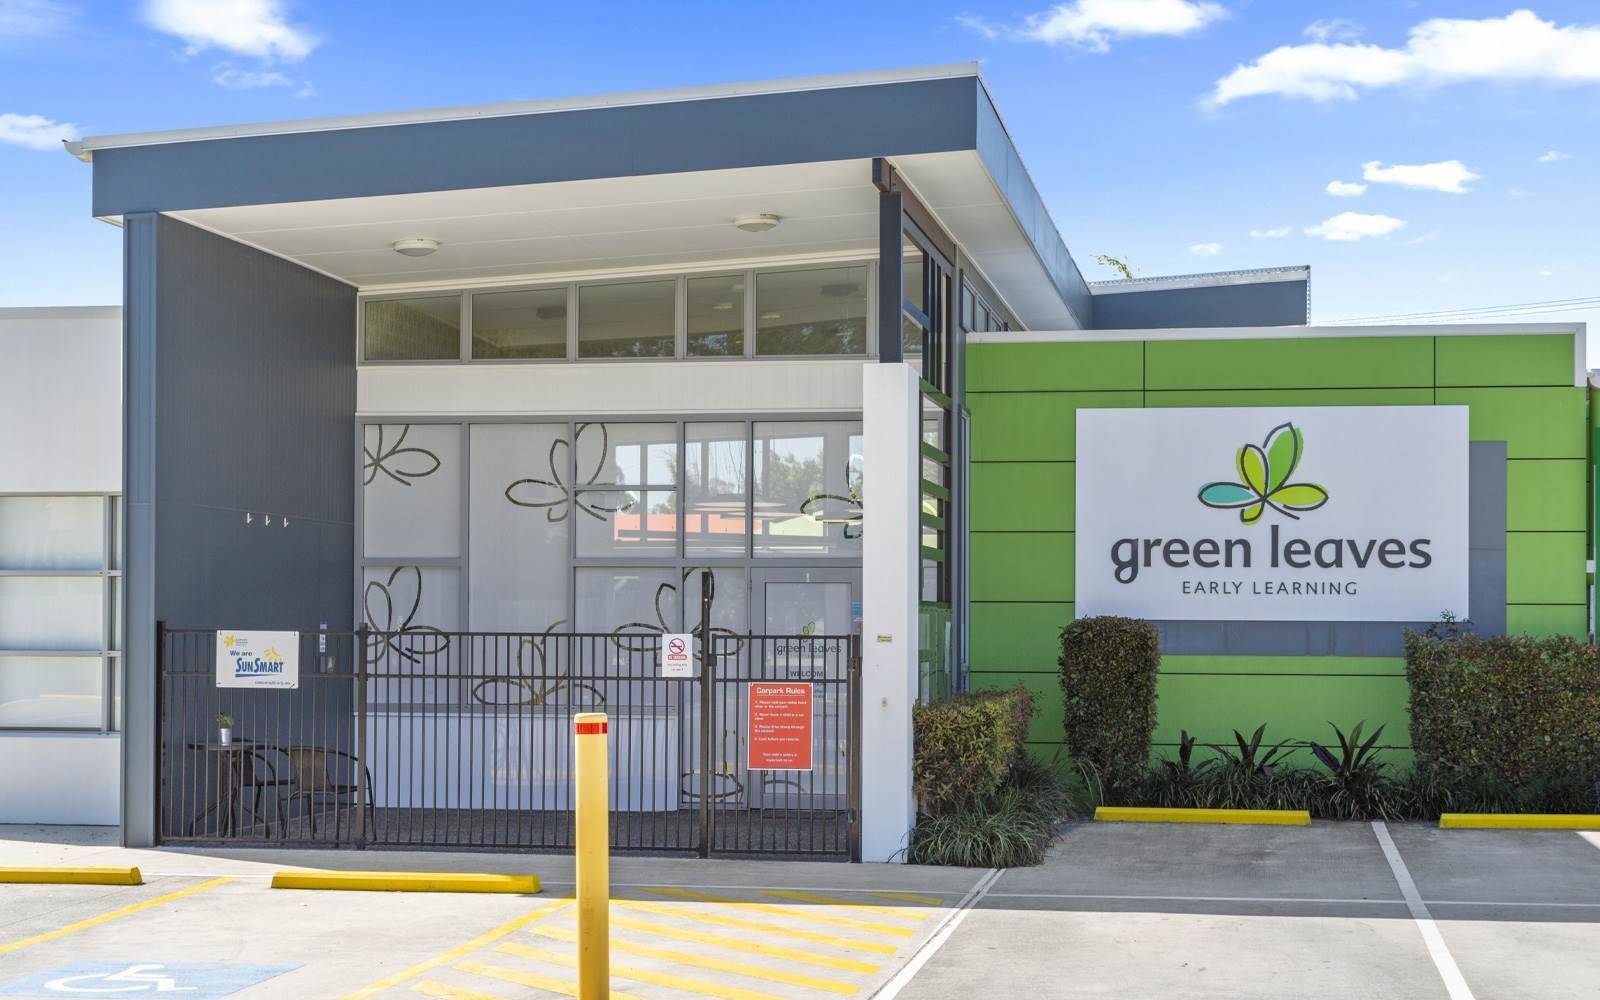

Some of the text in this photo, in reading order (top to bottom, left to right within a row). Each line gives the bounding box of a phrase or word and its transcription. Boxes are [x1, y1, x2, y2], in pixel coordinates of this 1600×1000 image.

[1111, 524, 1433, 585] green leaves
[1182, 581, 1358, 595] EARLY LEARNING
[776, 644, 806, 656] green
[757, 687, 784, 695] Carpark
